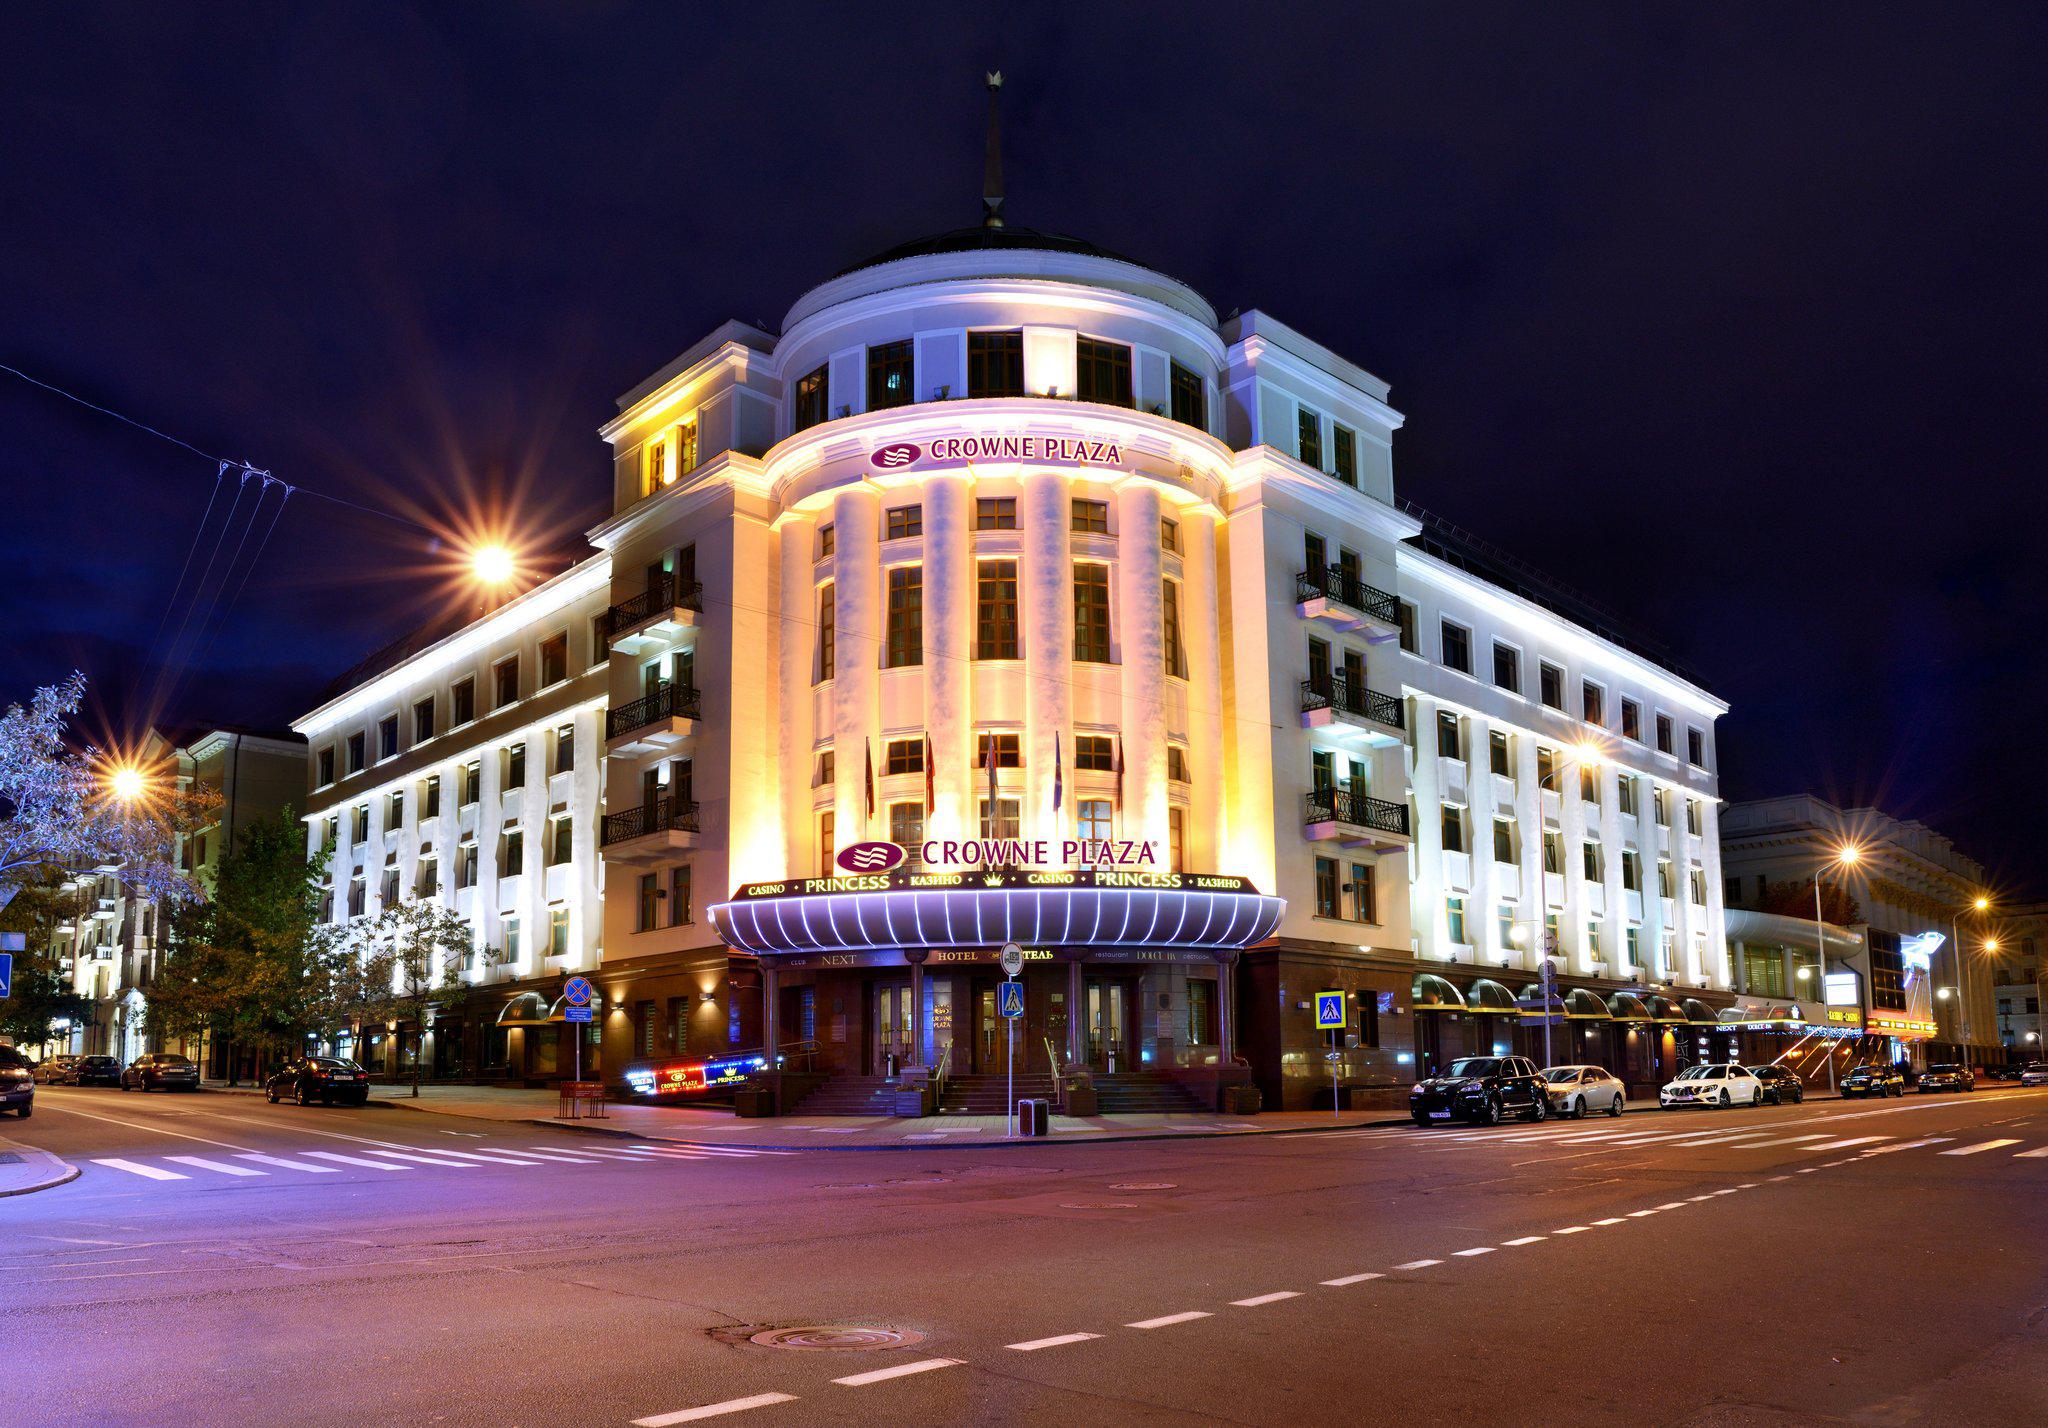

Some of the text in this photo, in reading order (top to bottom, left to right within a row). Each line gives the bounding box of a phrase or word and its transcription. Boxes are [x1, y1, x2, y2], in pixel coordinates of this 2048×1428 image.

[931, 437, 1121, 463] CROWNE PLAZA
[922, 840, 1048, 865] CROWNE
[748, 872, 1241, 896] CASINO PRINCESS КАЗИНО CASINO PRINCESS КАЗИНО
[938, 952, 979, 961] HOTEL
[1022, 950, 1054, 960] ТЕЛЬ
[821, 955, 857, 966] NEXT
[1715, 1024, 1738, 1032] NEXT
[717, 1075, 745, 1084] PRINCESS
[660, 1081, 681, 1090] CROWNE
